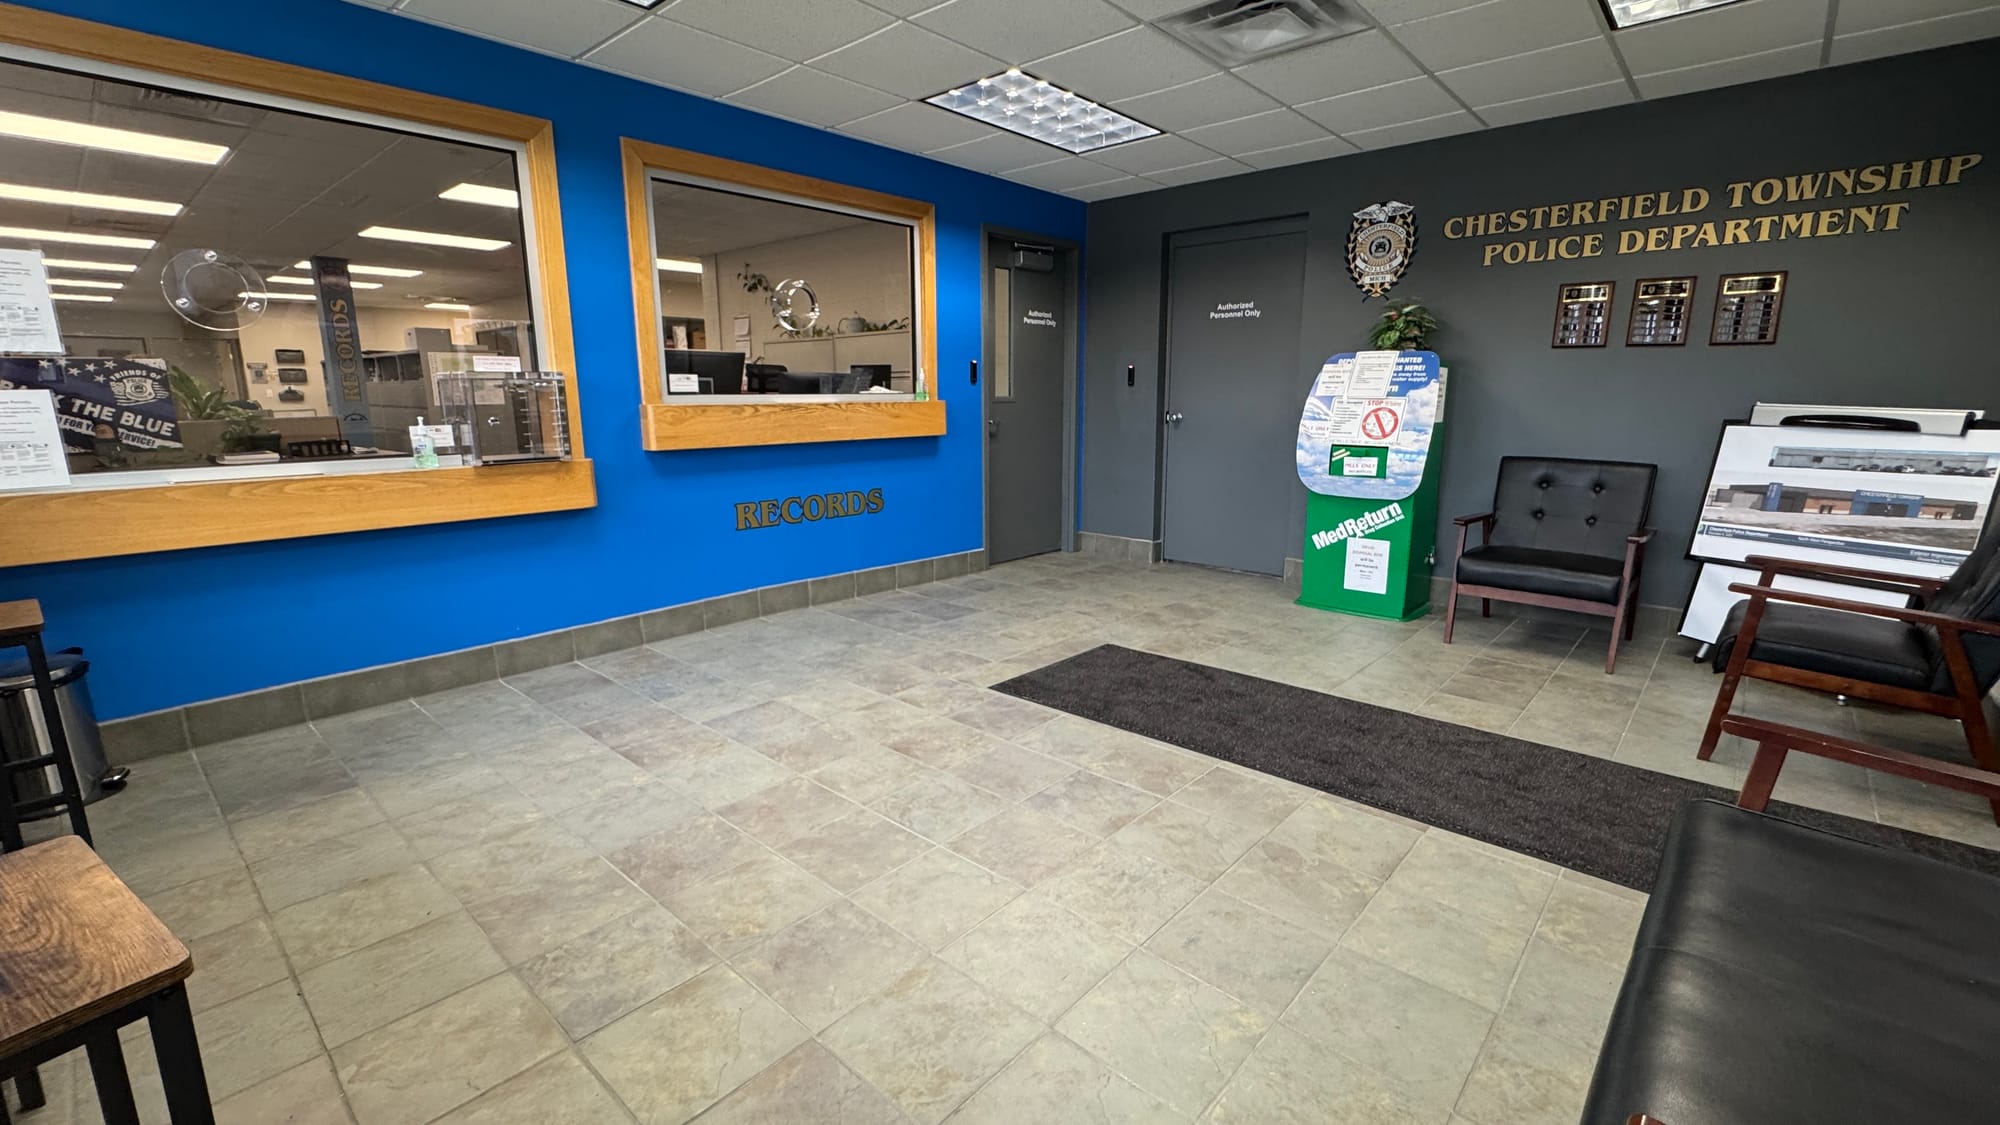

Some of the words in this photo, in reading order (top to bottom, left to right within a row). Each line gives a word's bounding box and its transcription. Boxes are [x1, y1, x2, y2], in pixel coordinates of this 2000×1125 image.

[1443, 187, 1710, 240] CHESTERFIELD
[1726, 153, 1983, 209] TOWNSHIP
[1482, 233, 1604, 267] POLICE
[1617, 202, 1910, 255] DEPARTMENT
[1028, 309, 1052, 318] Authorized
[1210, 310, 1243, 319] Personnel
[1244, 309, 1261, 318] Only
[1217, 301, 1254, 310] Authorized
[1023, 316, 1045, 325] Personnel
[1046, 318, 1056, 328] Only
[330, 299, 361, 401] RECORDS
[109, 369, 147, 381] FRIENDS
[63, 418, 82, 429] FOR
[71, 398, 116, 421] THE
[119, 411, 175, 436] BLUE
[734, 488, 884, 531] RECORDS
[1312, 502, 1402, 549] MedReturn
